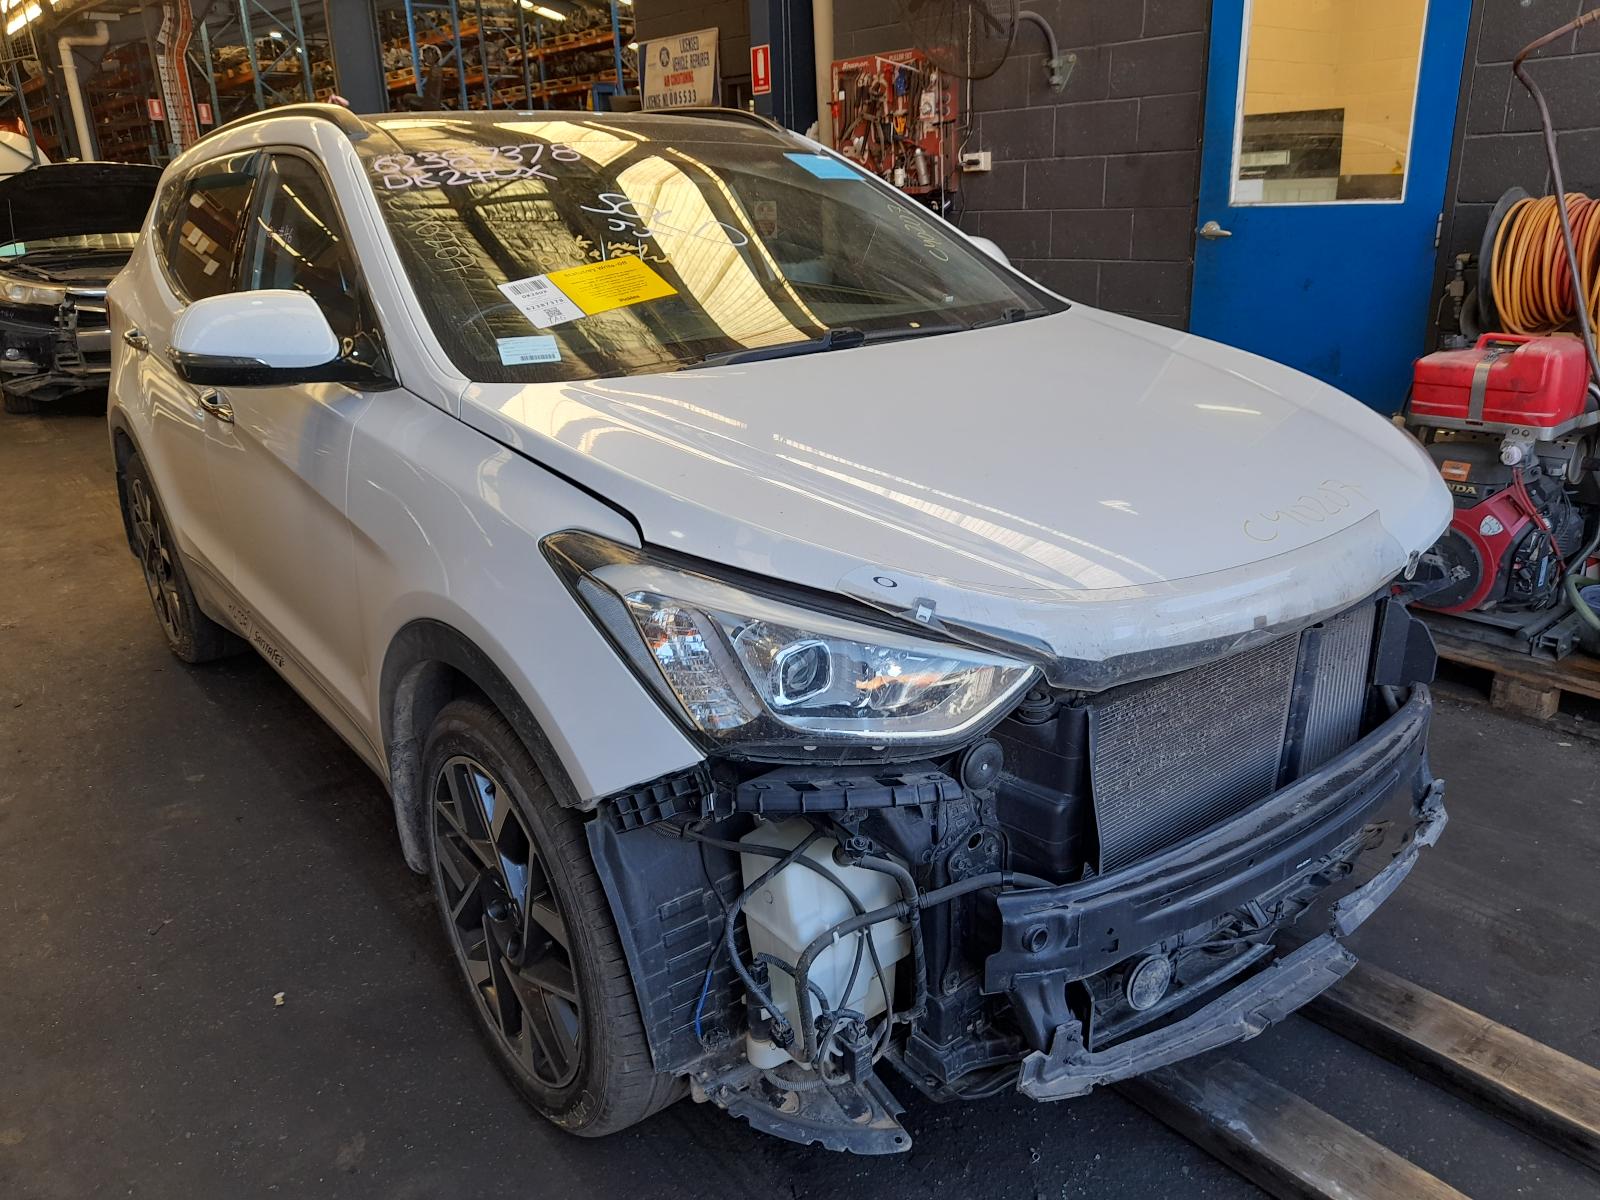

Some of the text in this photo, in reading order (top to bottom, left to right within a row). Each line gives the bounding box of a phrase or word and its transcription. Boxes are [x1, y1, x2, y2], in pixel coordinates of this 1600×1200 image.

[669, 89, 697, 106] 005533
[374, 143, 581, 174] 62387378
[1447, 483, 1477, 495] NDA
